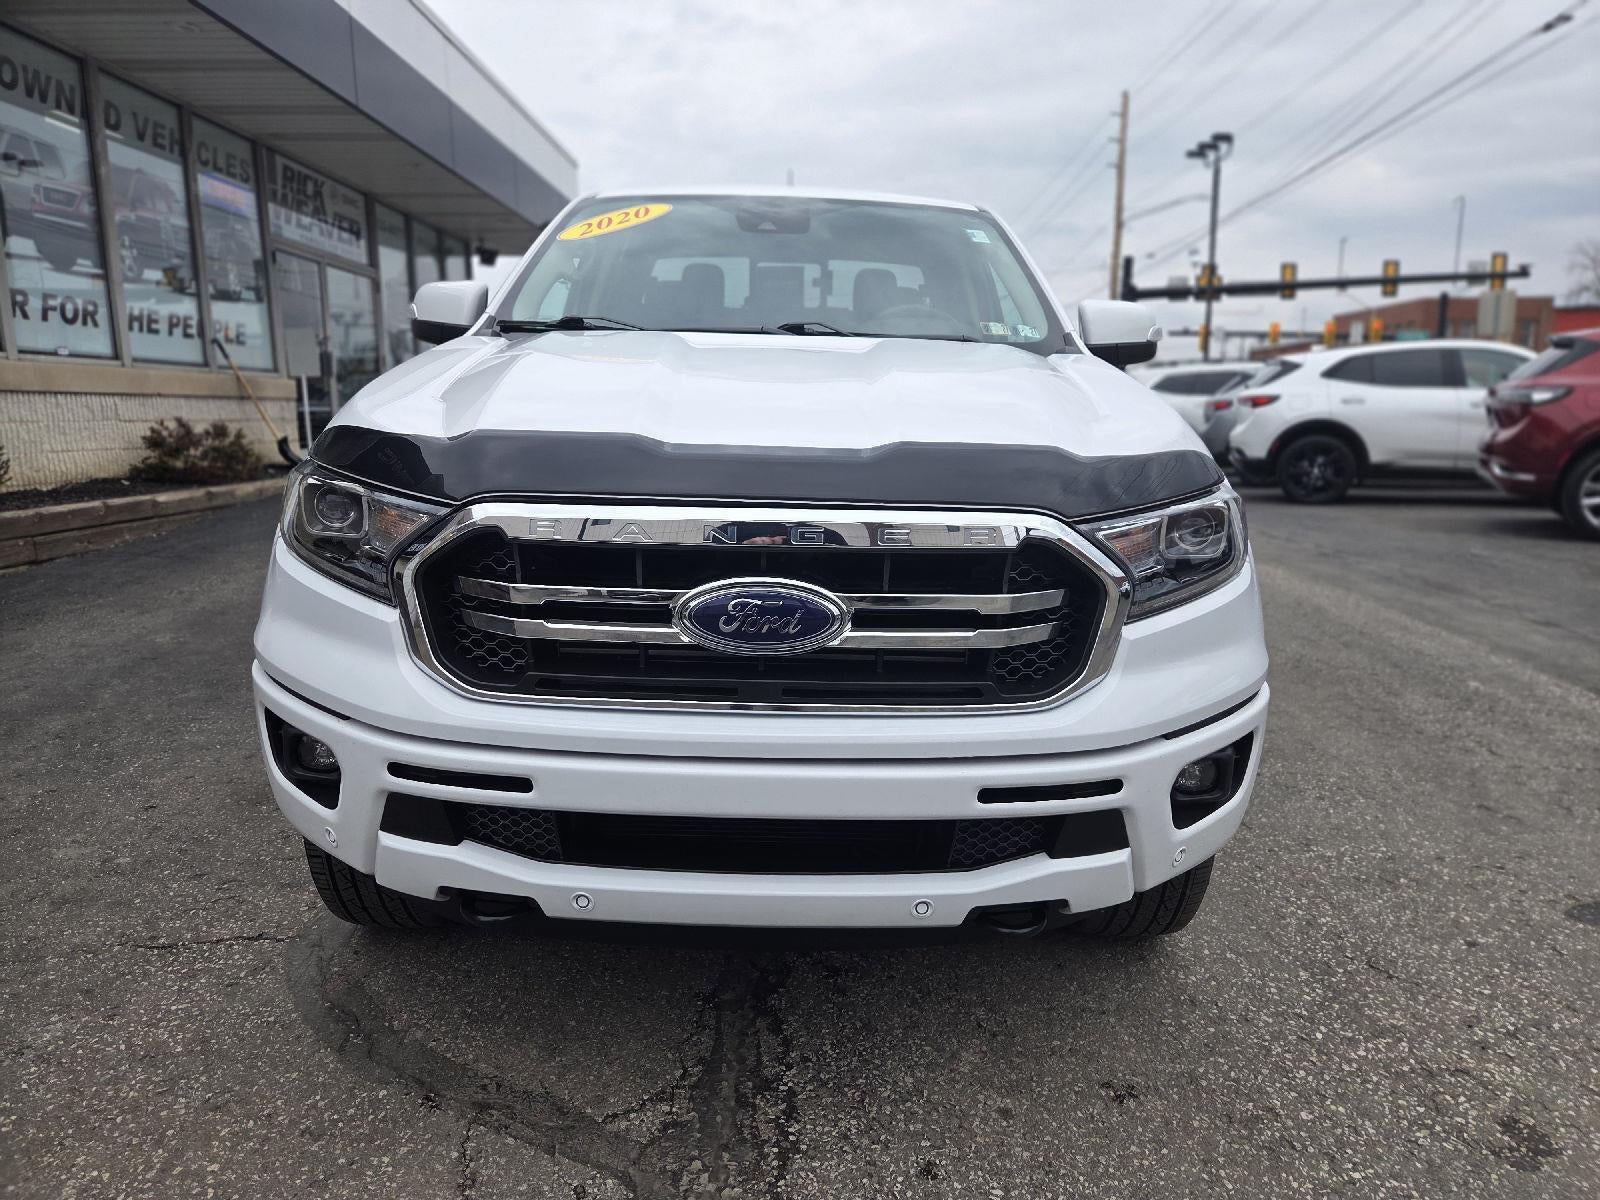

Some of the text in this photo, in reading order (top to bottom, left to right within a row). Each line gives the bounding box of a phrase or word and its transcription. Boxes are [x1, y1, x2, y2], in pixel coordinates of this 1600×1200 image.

[0, 56, 250, 184] OWND VEHCLES
[282, 163, 326, 207] RICK
[579, 207, 650, 236] 2020
[41, 293, 99, 328] FOR
[128, 306, 160, 335] HE
[168, 313, 247, 346] PEPLE
[529, 518, 998, 547] RANGER
[718, 598, 804, 634] Ford
